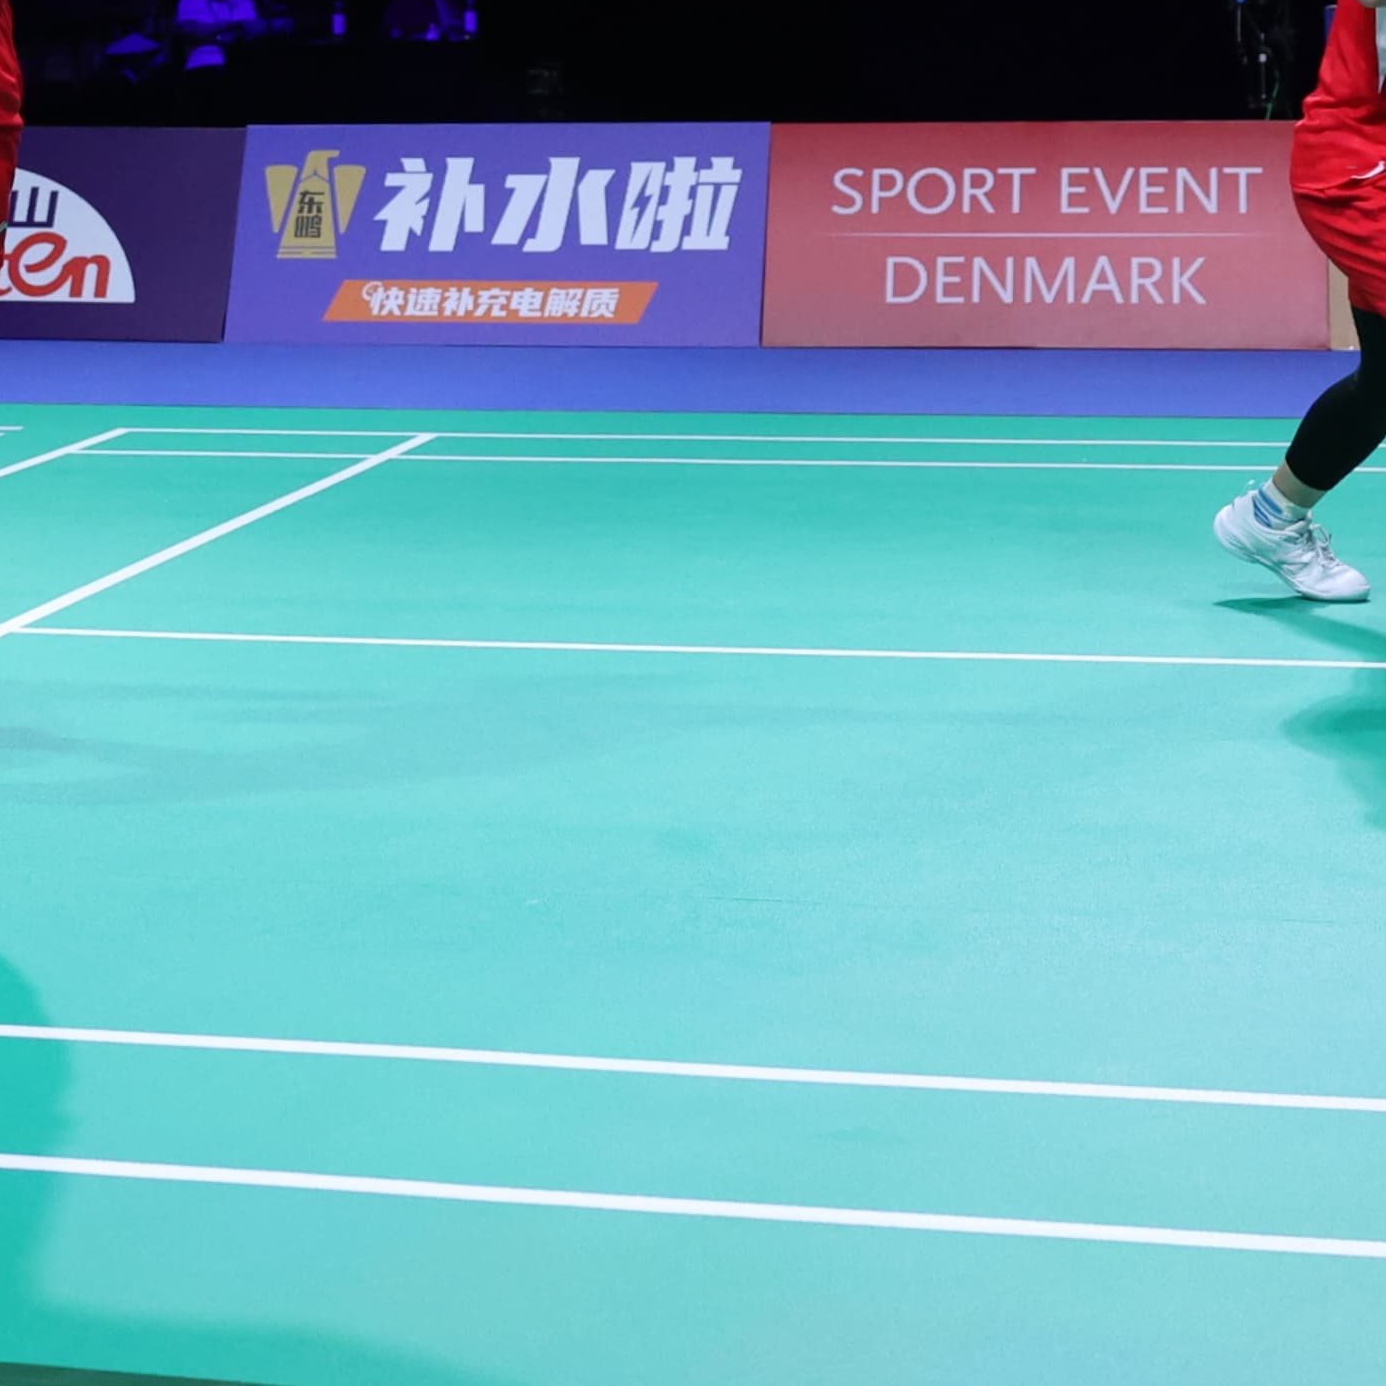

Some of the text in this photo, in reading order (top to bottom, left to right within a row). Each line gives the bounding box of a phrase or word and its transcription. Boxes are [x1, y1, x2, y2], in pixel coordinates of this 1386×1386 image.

[373, 156, 743, 254] 补水啦
[830, 166, 1264, 216] SPORT EVENT
[370, 286, 619, 318] 快速补充电解质
[885, 255, 1208, 305] DENMARK
